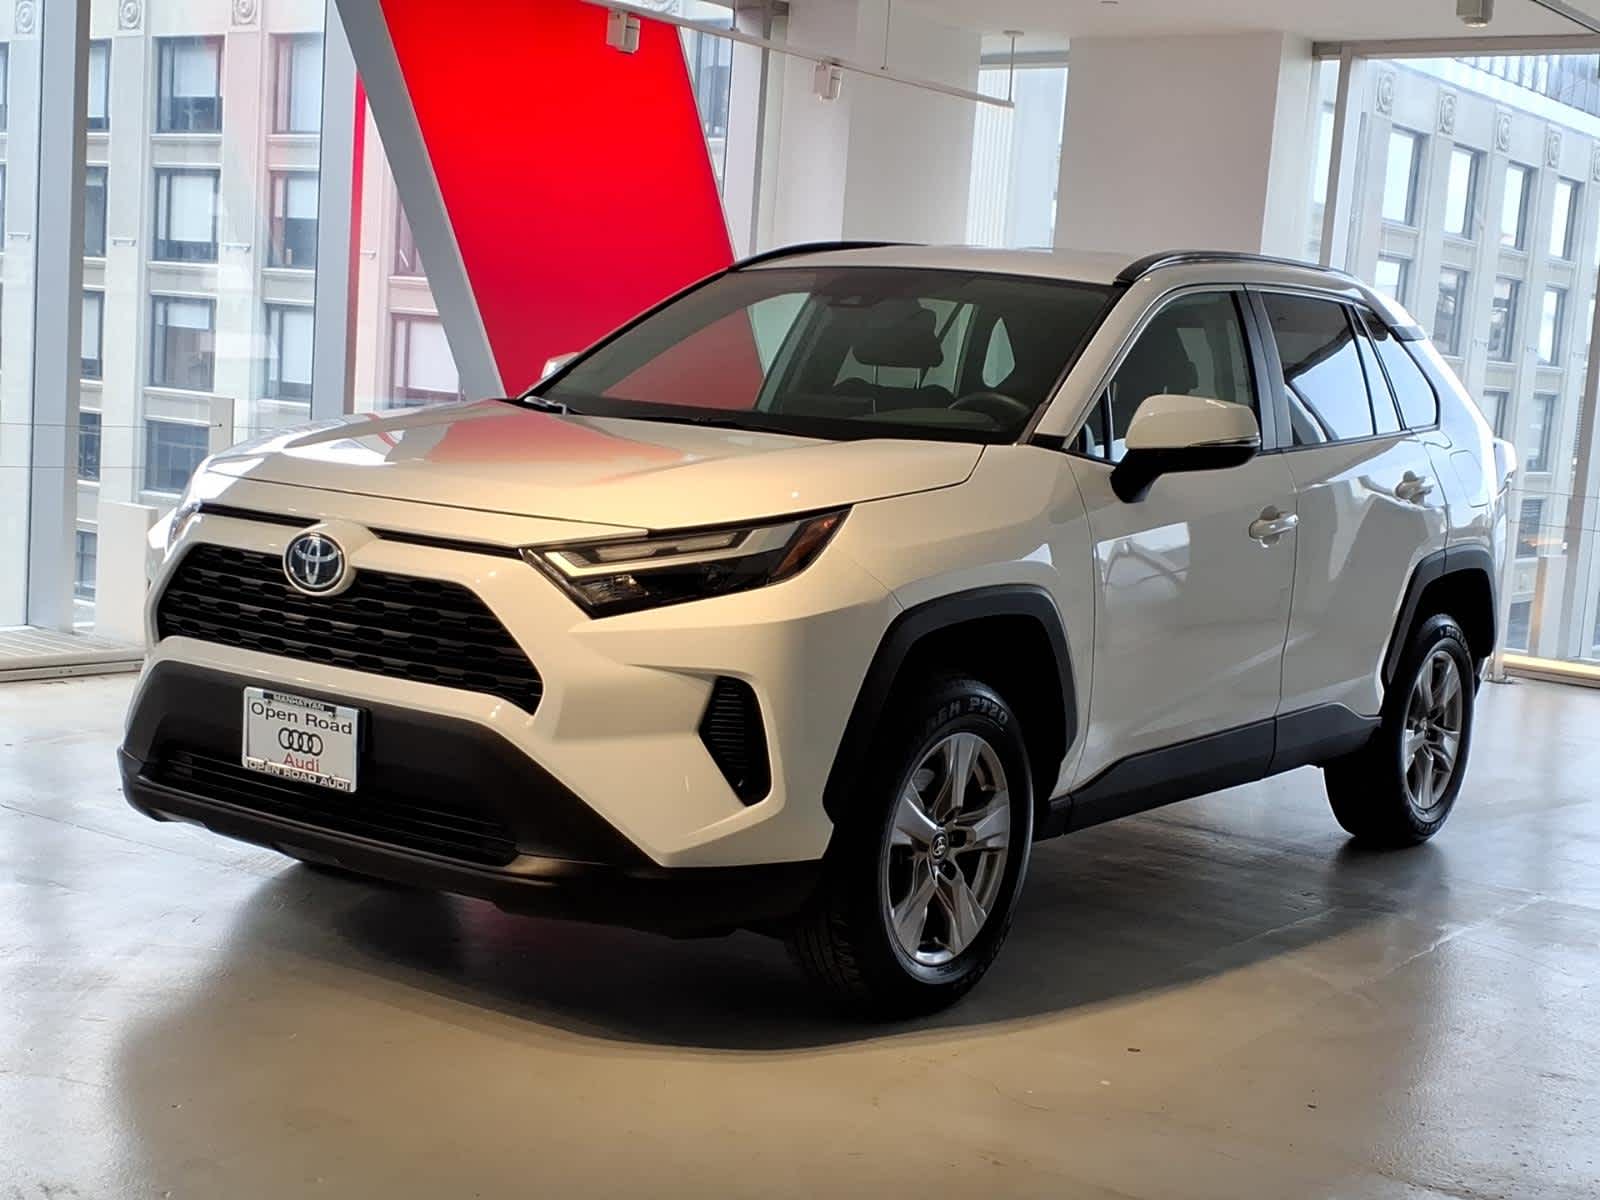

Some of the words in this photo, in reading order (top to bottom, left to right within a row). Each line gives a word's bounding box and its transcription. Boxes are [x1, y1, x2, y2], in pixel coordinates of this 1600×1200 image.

[251, 702, 298, 723] Open
[306, 713, 352, 735] Road
[249, 762, 280, 775] OPEN
[284, 768, 317, 783] ROAD
[320, 778, 348, 790] AUDI
[283, 753, 320, 772] Audi
